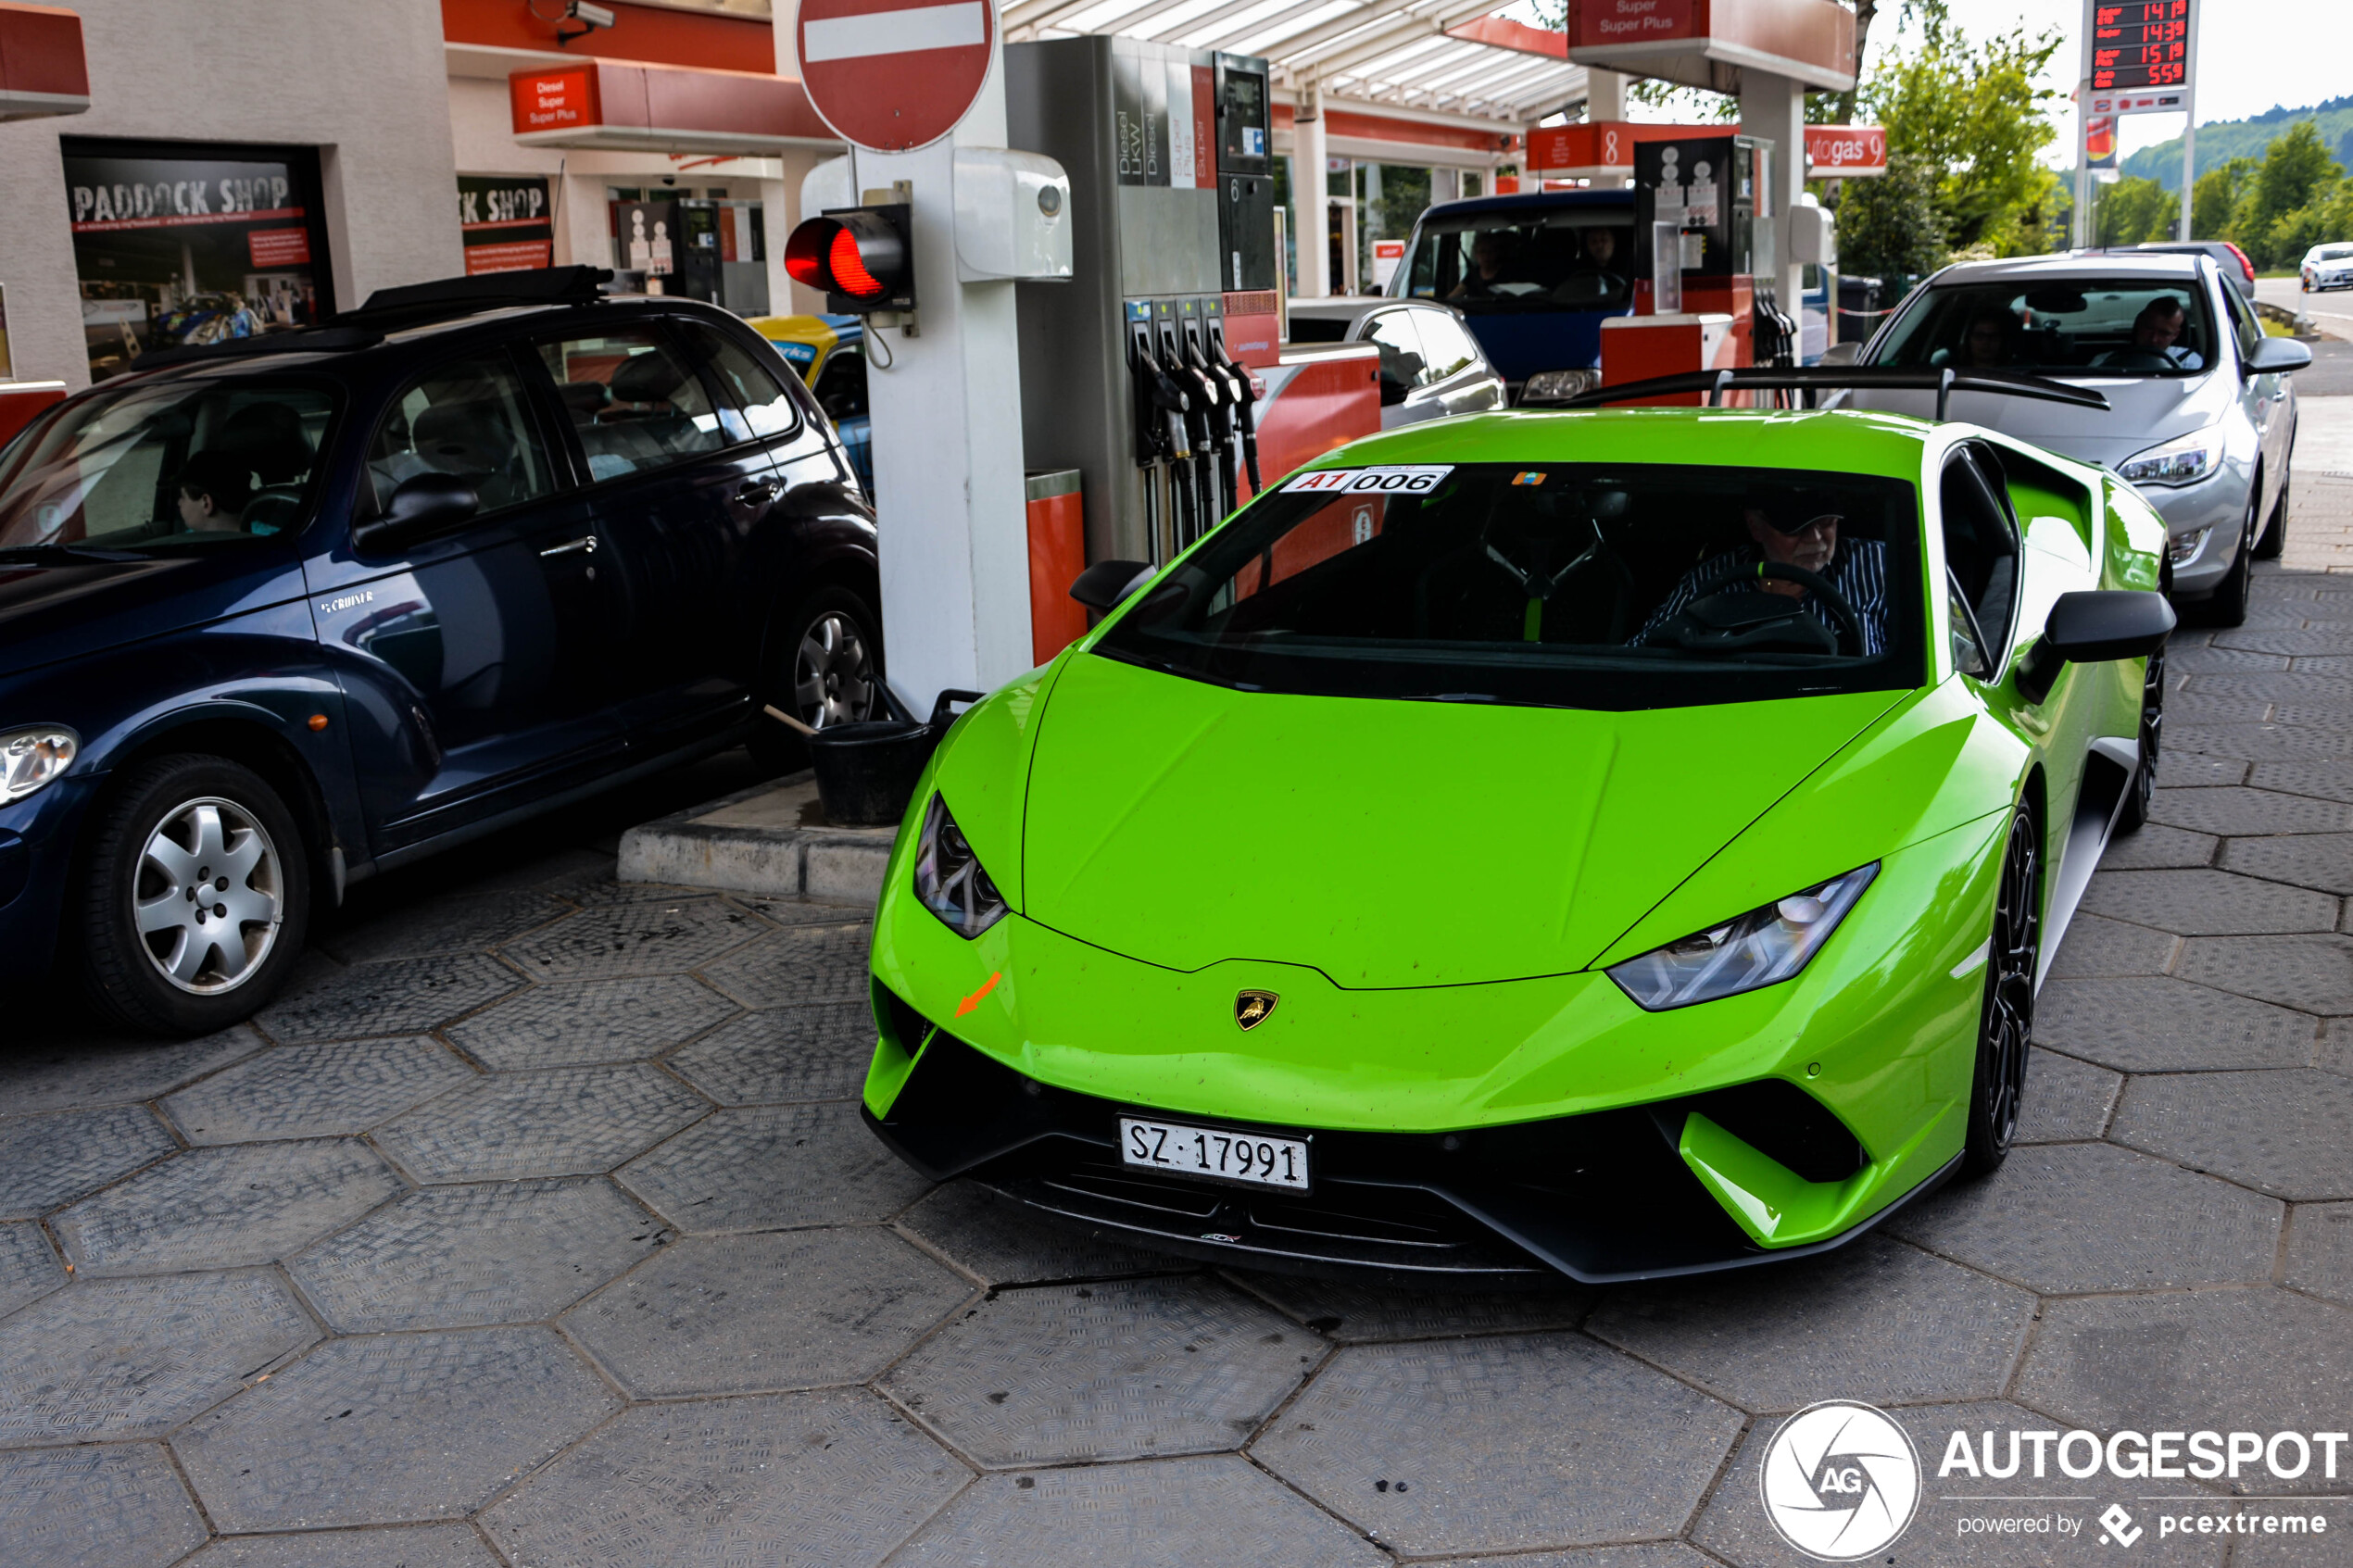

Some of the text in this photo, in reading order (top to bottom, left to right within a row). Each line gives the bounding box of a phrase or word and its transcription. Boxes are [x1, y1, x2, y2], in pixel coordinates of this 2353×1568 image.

[1617, 0, 1656, 14] Super
[1600, 17, 1673, 34] Super Plus
[2143, 20, 2185, 43] 1439
[536, 80, 564, 94] Diesel
[2148, 63, 2183, 84] 559
[530, 109, 577, 124] Super Plus
[538, 96, 564, 109] Super
[1117, 111, 1130, 175] Diesel
[1130, 122, 1142, 175] LKW
[1146, 113, 1157, 176] Diesel
[1173, 117, 1183, 177] Super
[1184, 135, 1193, 177] Plus
[1197, 119, 1207, 178] Super
[1605, 130, 1618, 164] 8
[1869, 134, 1883, 166] 9
[74, 176, 289, 222] PADDOCK SHOP
[486, 187, 543, 221] SHOP
[1230, 178, 1239, 203] 6
[1296, 473, 1437, 490] A1 006
